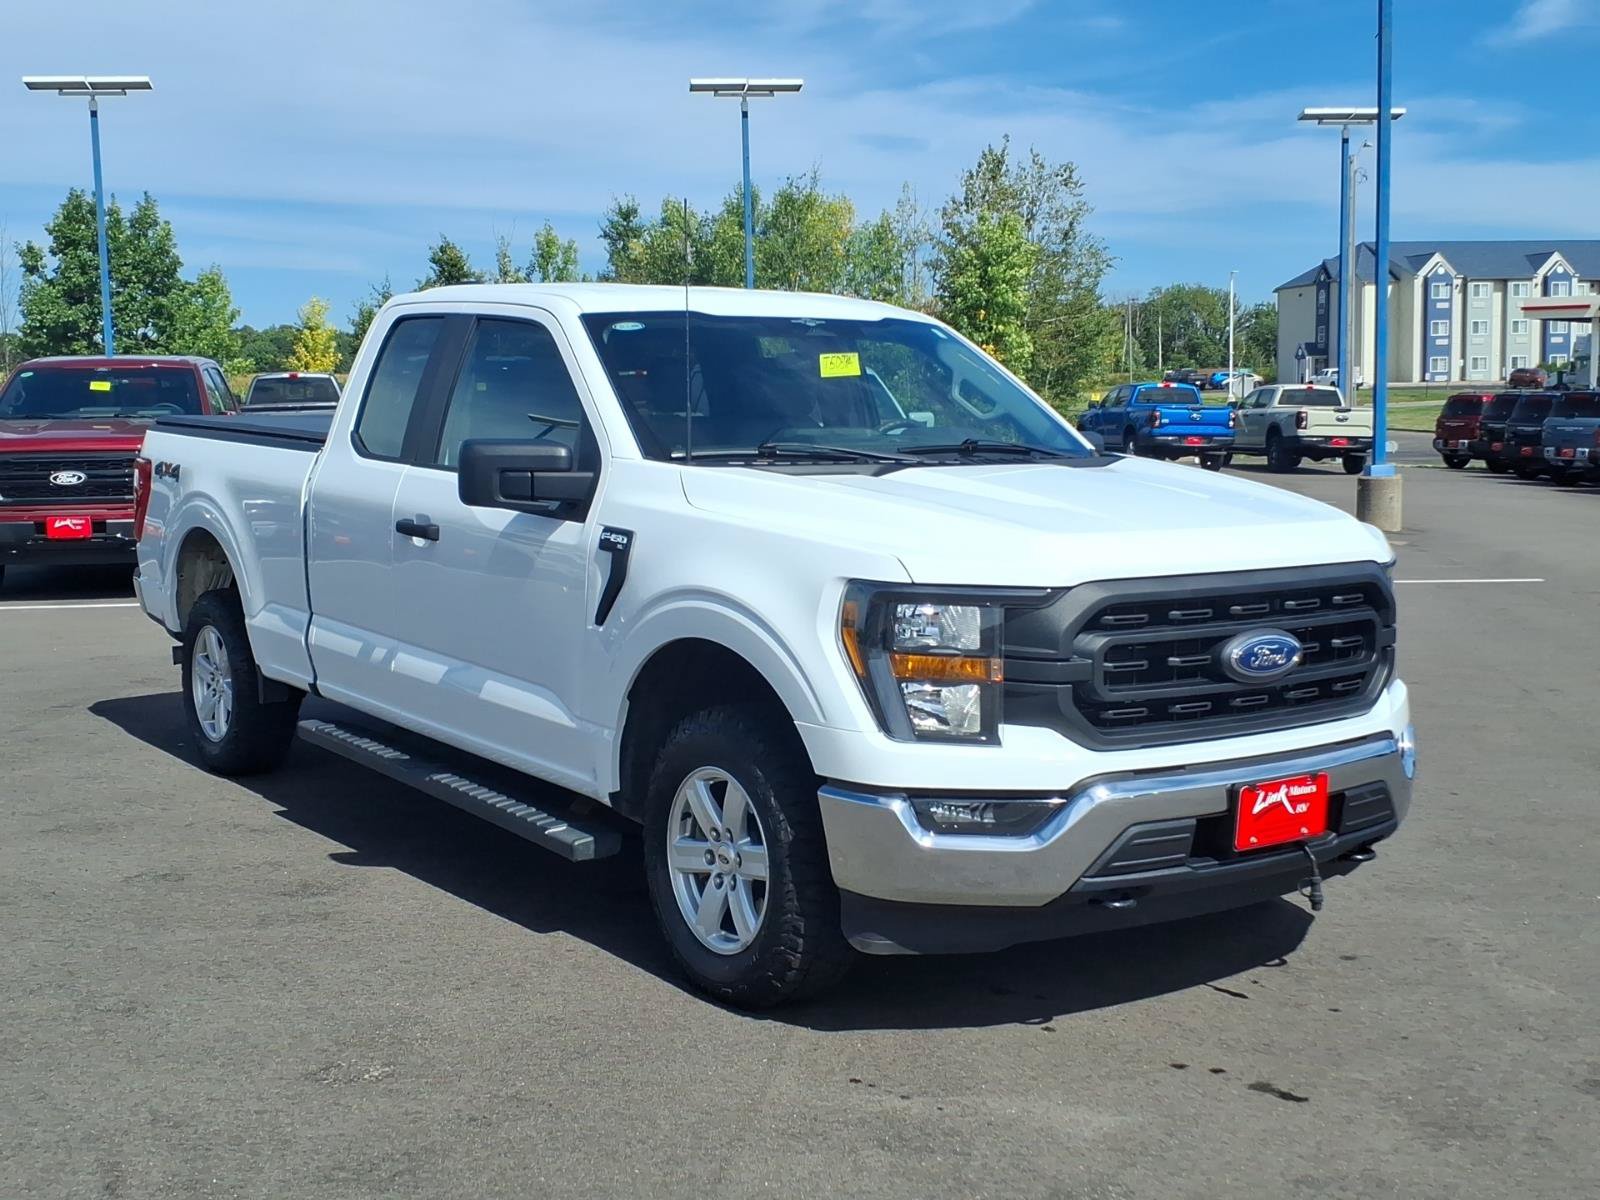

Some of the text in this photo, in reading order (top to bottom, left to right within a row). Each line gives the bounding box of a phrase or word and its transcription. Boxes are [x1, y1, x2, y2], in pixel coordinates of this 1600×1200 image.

[1250, 644, 1289, 668] Ford
[1252, 784, 1318, 815] Link Motors
